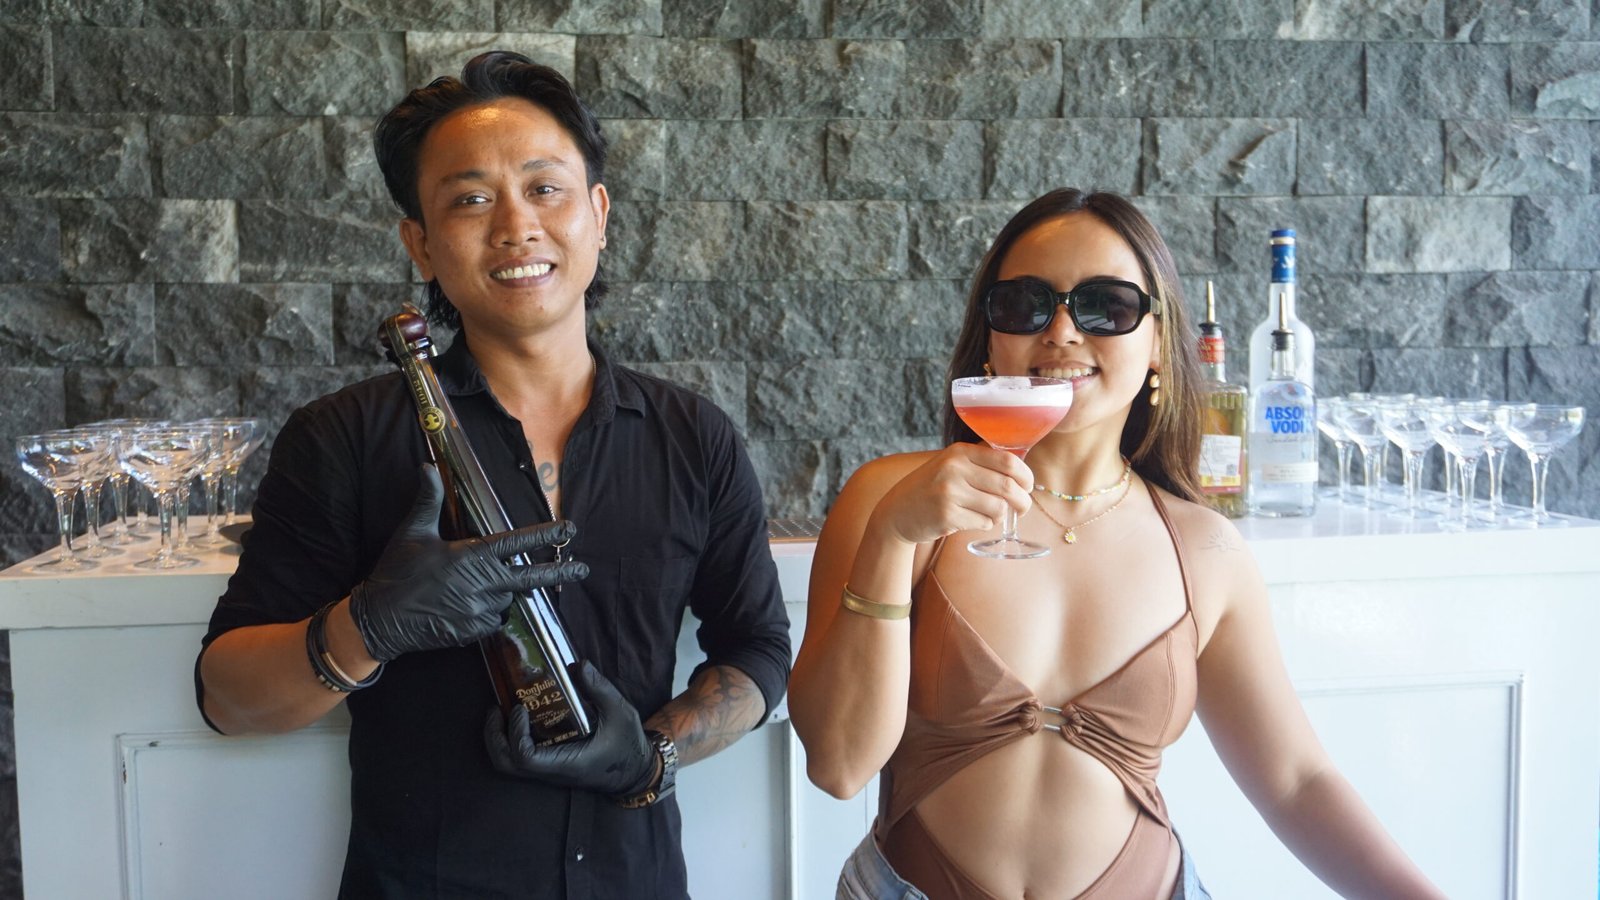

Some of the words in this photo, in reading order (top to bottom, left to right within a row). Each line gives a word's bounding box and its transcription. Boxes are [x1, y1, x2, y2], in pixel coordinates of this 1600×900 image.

[1265, 406, 1306, 420] ABSO
[1270, 420, 1306, 434] VOD
[523, 691, 564, 711] 1942
